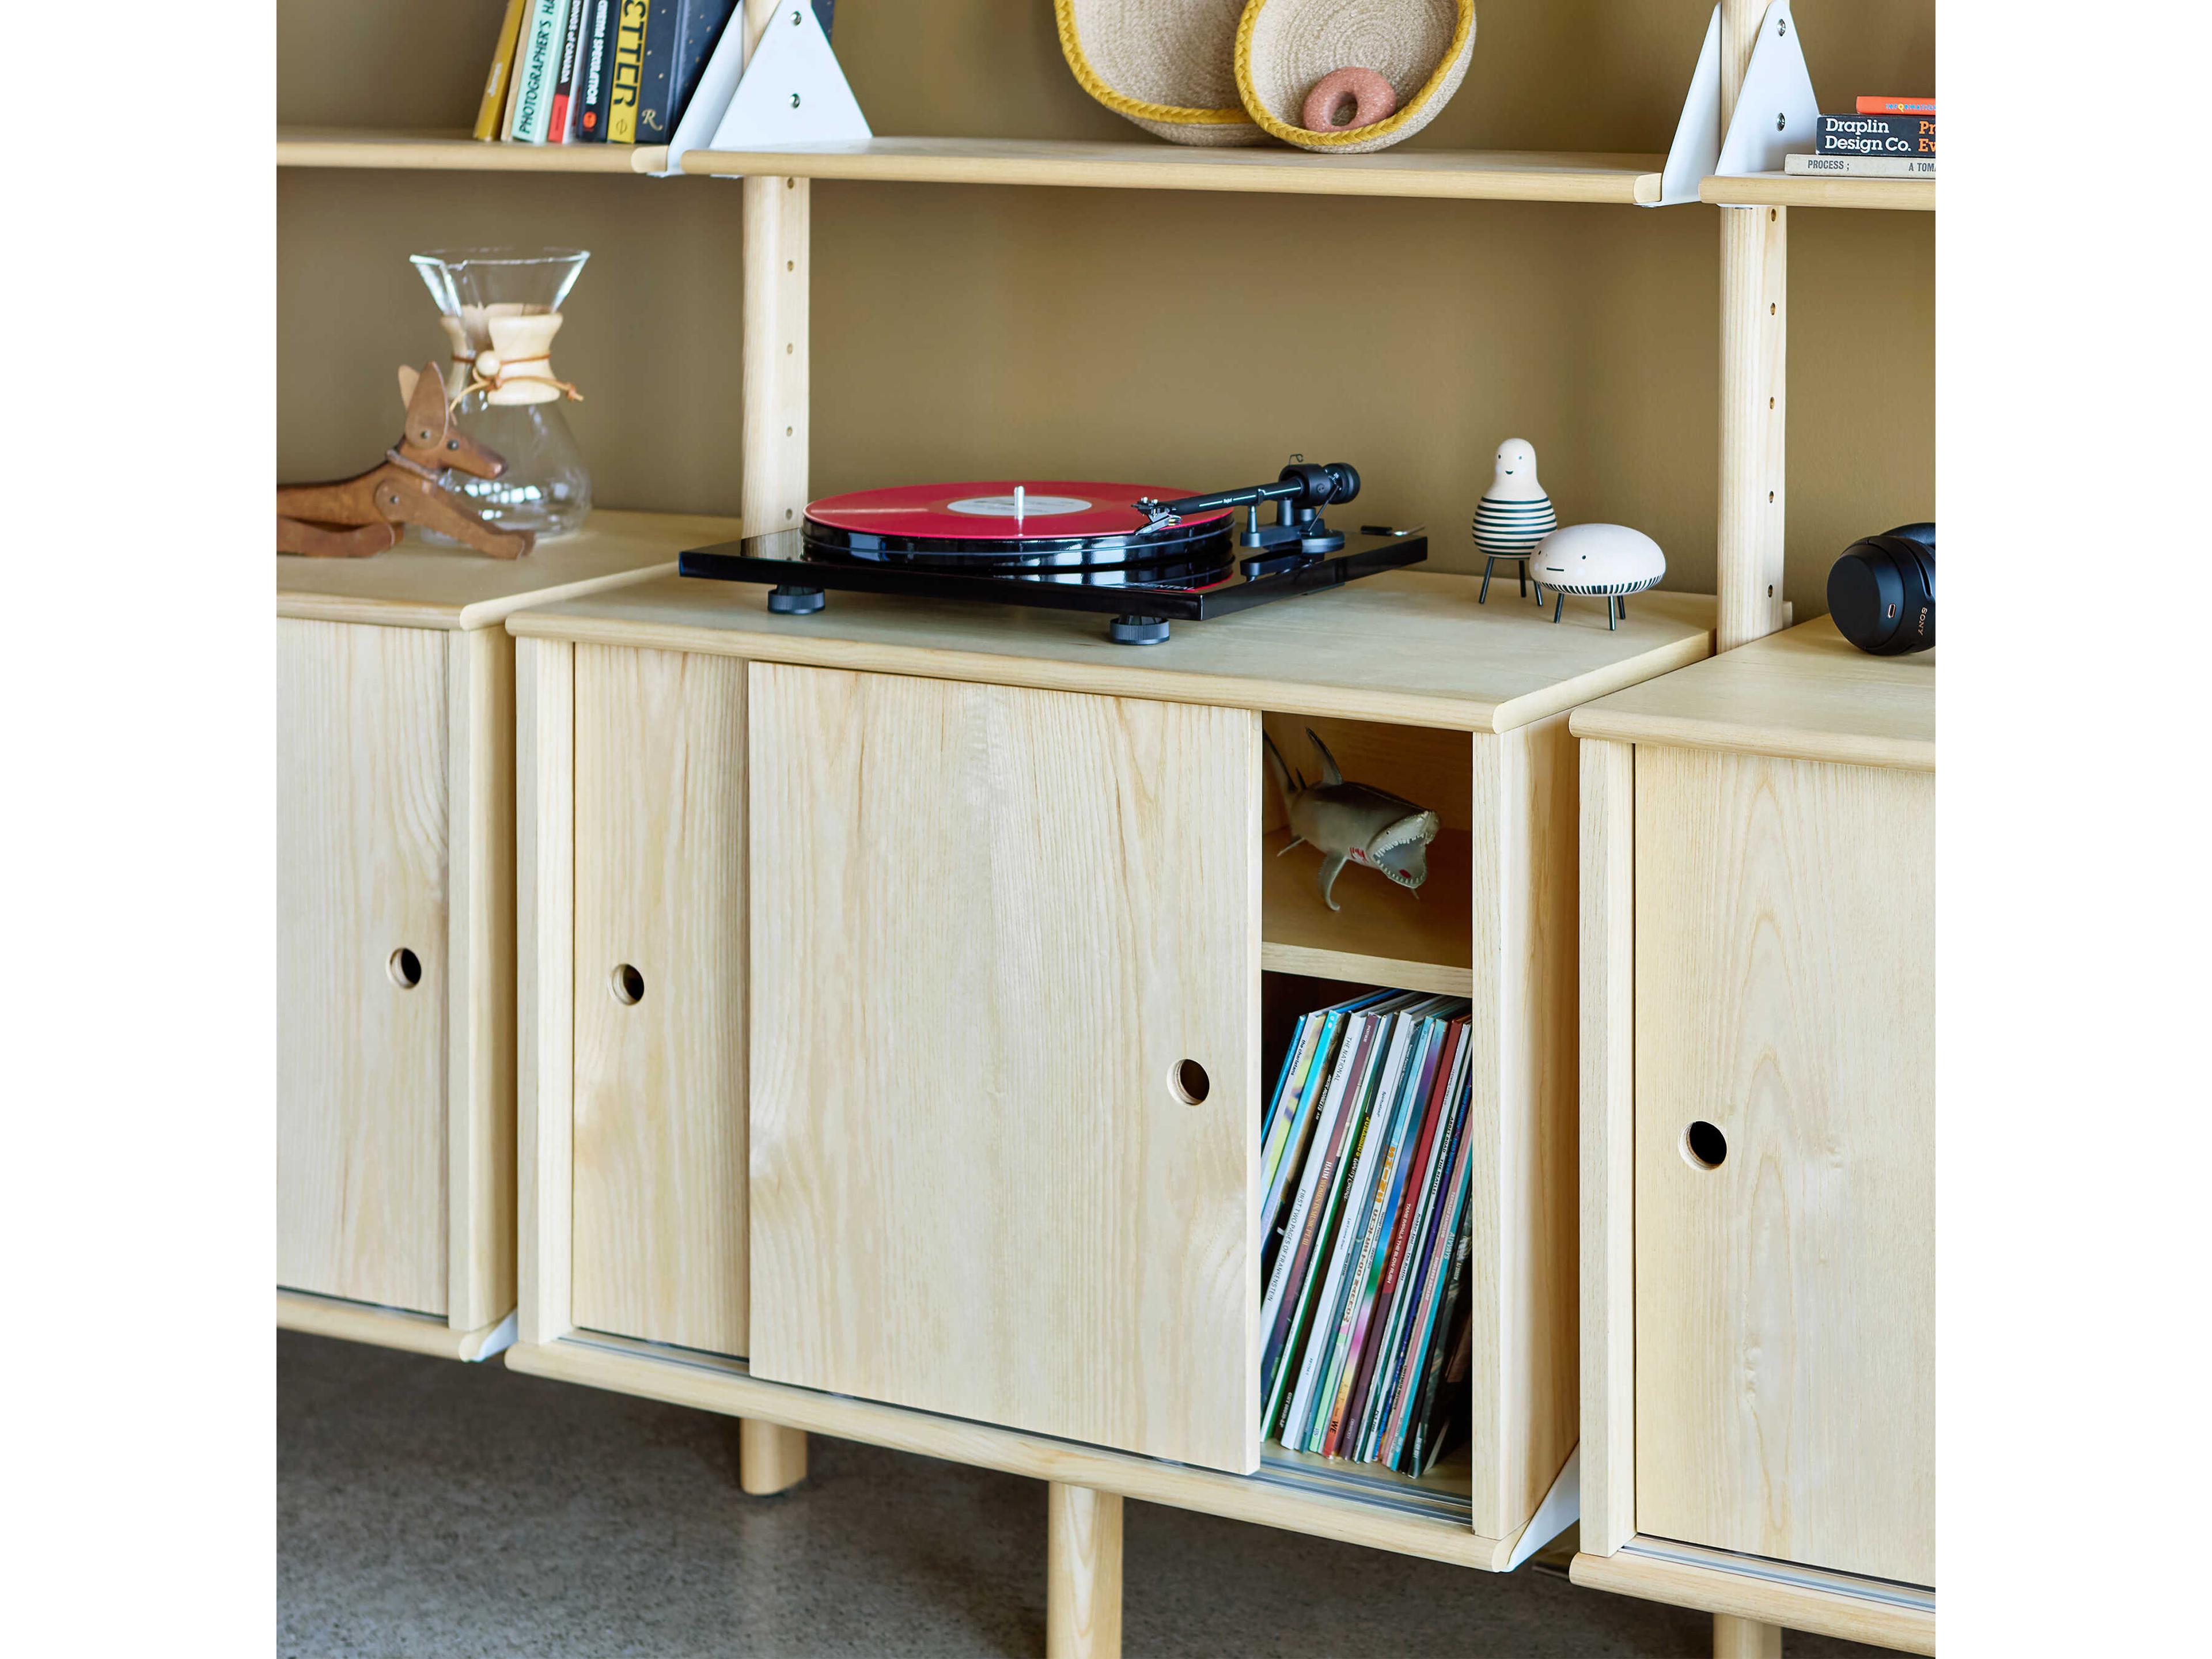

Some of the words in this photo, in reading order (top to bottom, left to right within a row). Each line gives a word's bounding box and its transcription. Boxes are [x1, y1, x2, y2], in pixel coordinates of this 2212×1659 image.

[519, 20, 551, 134] PHOTOGRAPHER'S
[586, 38, 604, 105] SPECULATION
[1825, 118, 1890, 135] Draplin
[1825, 136, 1883, 153] Design
[1885, 137, 1911, 151] Co.
[1808, 160, 1844, 169] PROCESS
[1908, 162, 1914, 171] A
[1917, 162, 1936, 172] TOM
[1918, 607, 1927, 636] SONY
[1344, 1036, 1352, 1048] THE
[1290, 1048, 1302, 1075] charlatans
[1334, 1049, 1347, 1082] NATIONAL
[1321, 1161, 1332, 1179] HAIM
[1315, 1179, 1327, 1203] WOMEN
[1431, 1171, 1440, 1195] BEATLES
[1296, 1188, 1306, 1206] FIRST
[1446, 1191, 1455, 1214] TEENAGE
[1290, 1209, 1300, 1224] TWO
[1306, 1210, 1317, 1228] MUSIC
[1440, 1214, 1449, 1238] FANCLUB
[1285, 1224, 1296, 1244] PAGES
[1398, 1218, 1407, 1239] IMPALA
[1281, 1245, 1289, 1253] OF
[1267, 1254, 1286, 1302] FRANKENSTEIN
[1400, 1262, 1408, 1281] Beatles
[1329, 1420, 1339, 1434] WE
